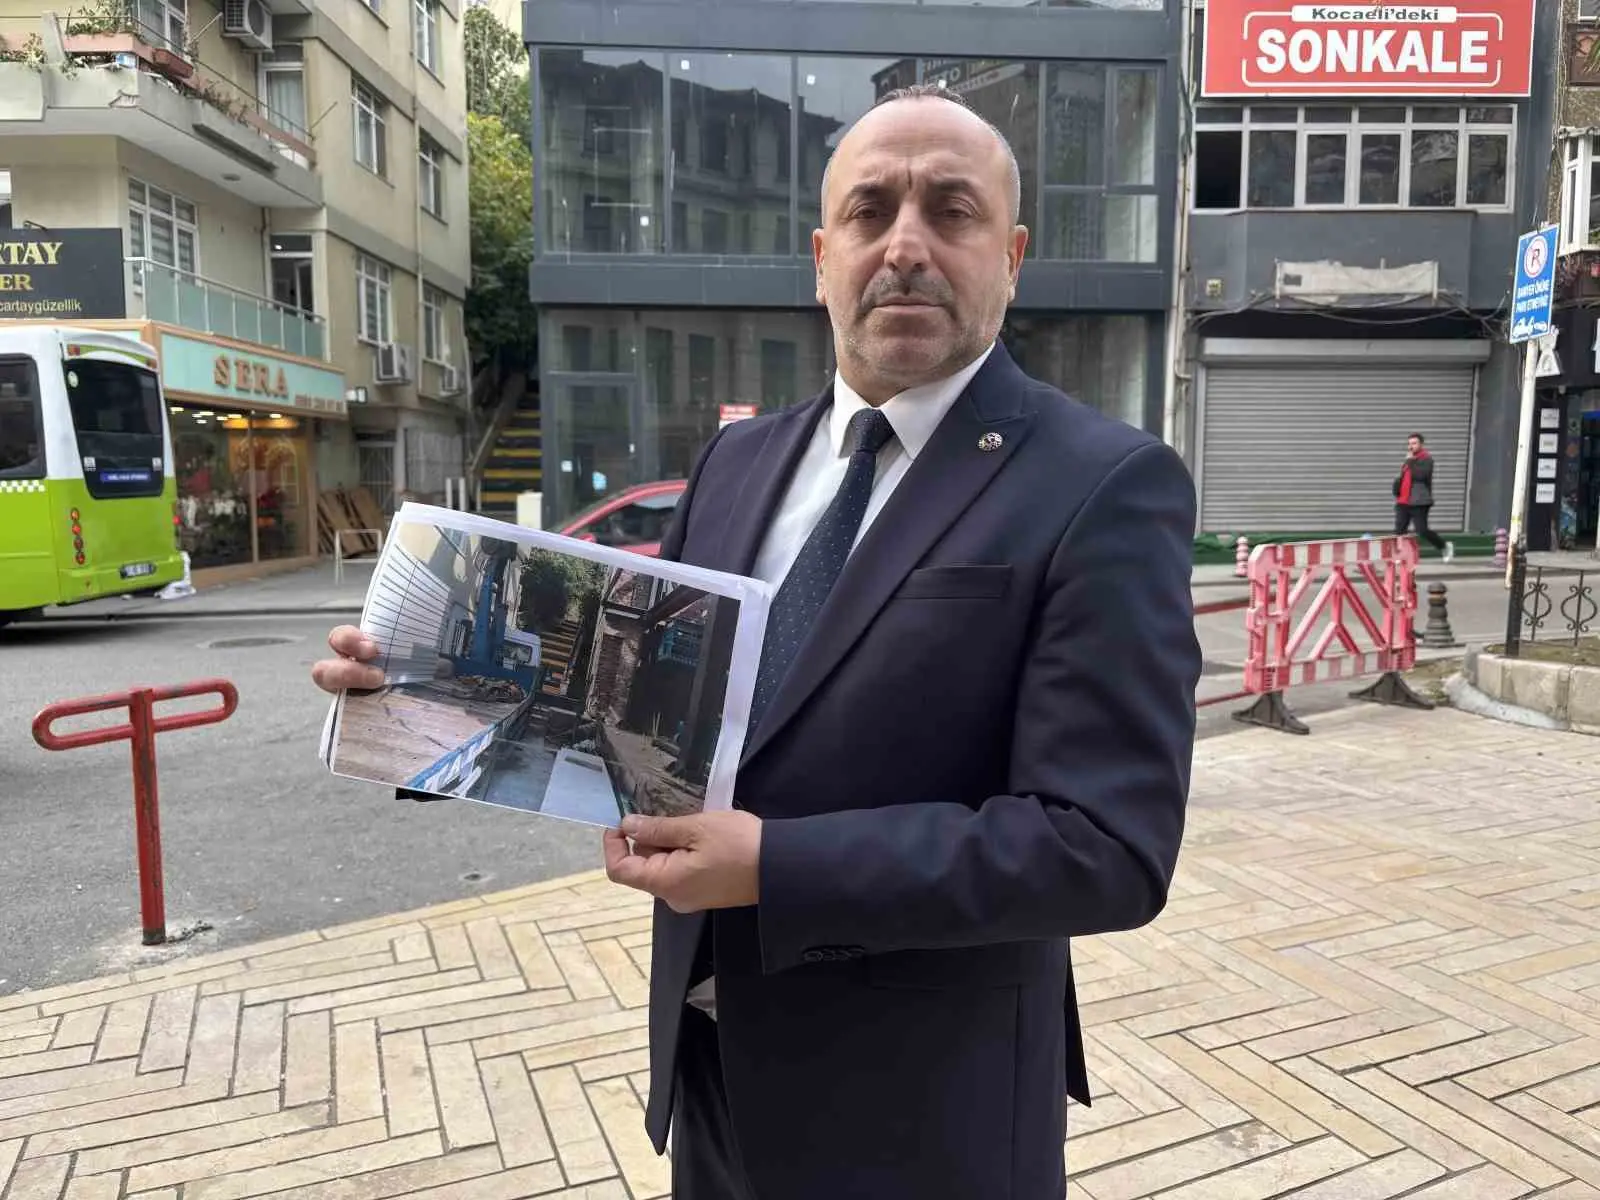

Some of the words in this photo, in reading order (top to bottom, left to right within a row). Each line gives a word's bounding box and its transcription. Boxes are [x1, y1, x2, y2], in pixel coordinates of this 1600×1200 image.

[1311, 8, 1439, 21] Kocaeli'deki
[1256, 29, 1489, 73] SONKALE
[0, 242, 63, 265] TAY
[214, 354, 289, 399] SERA
